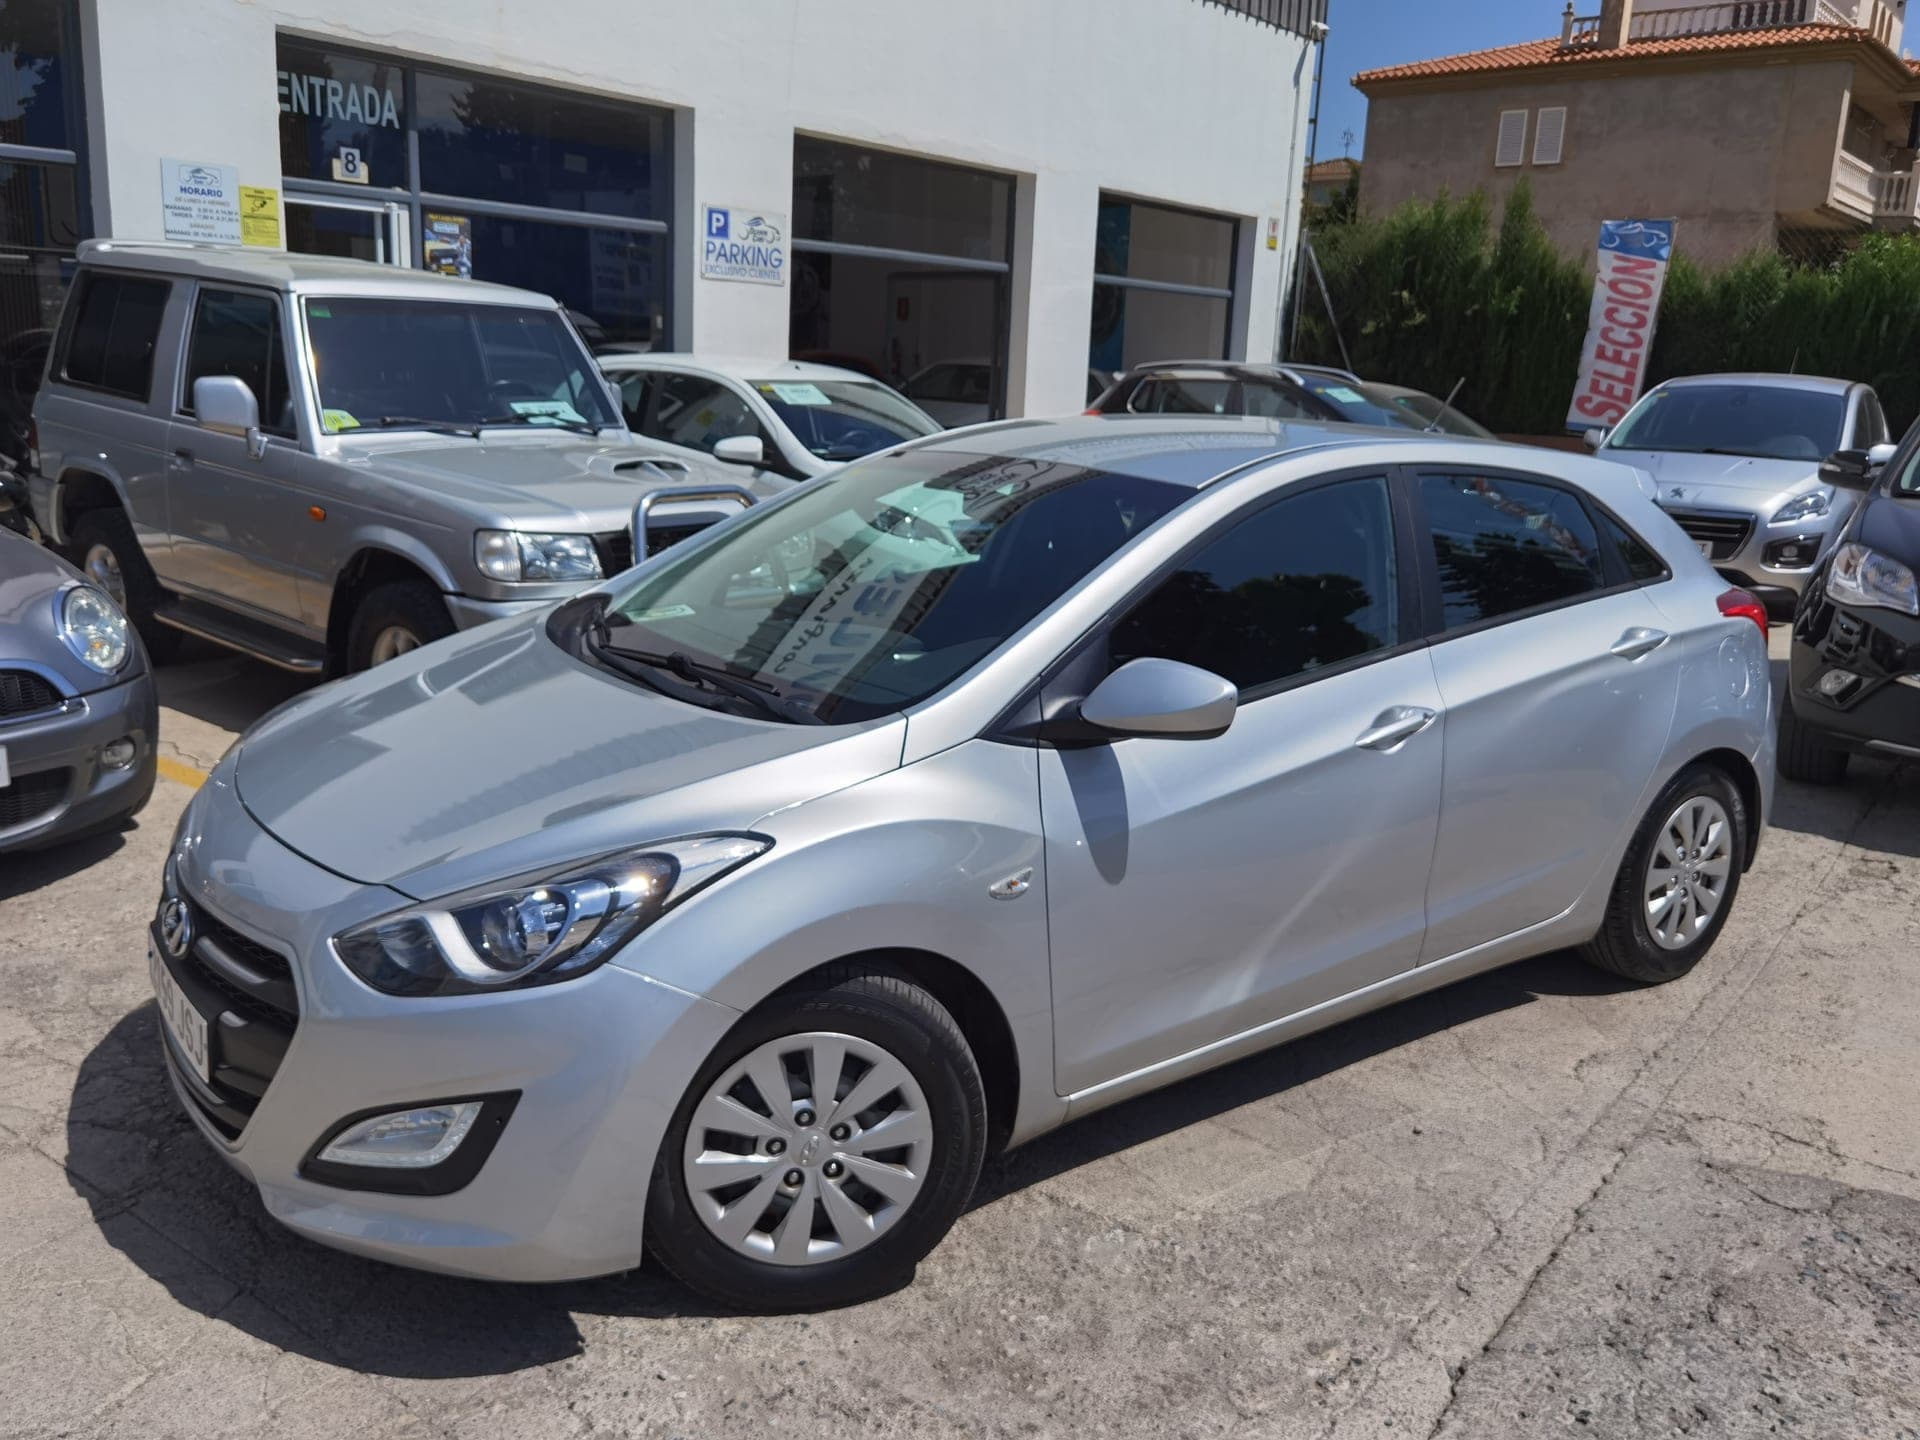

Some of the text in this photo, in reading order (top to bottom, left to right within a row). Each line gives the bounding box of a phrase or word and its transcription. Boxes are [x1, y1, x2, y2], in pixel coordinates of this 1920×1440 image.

[277, 71, 400, 129] ENTRADA
[344, 152, 357, 174] 8
[180, 186, 223, 198] HORARIO
[711, 212, 725, 235] P
[705, 240, 783, 269] PARKING
[705, 264, 781, 280] EXCLUSIVO CLIENTES
[1575, 254, 1657, 426] SELECCIÓN
